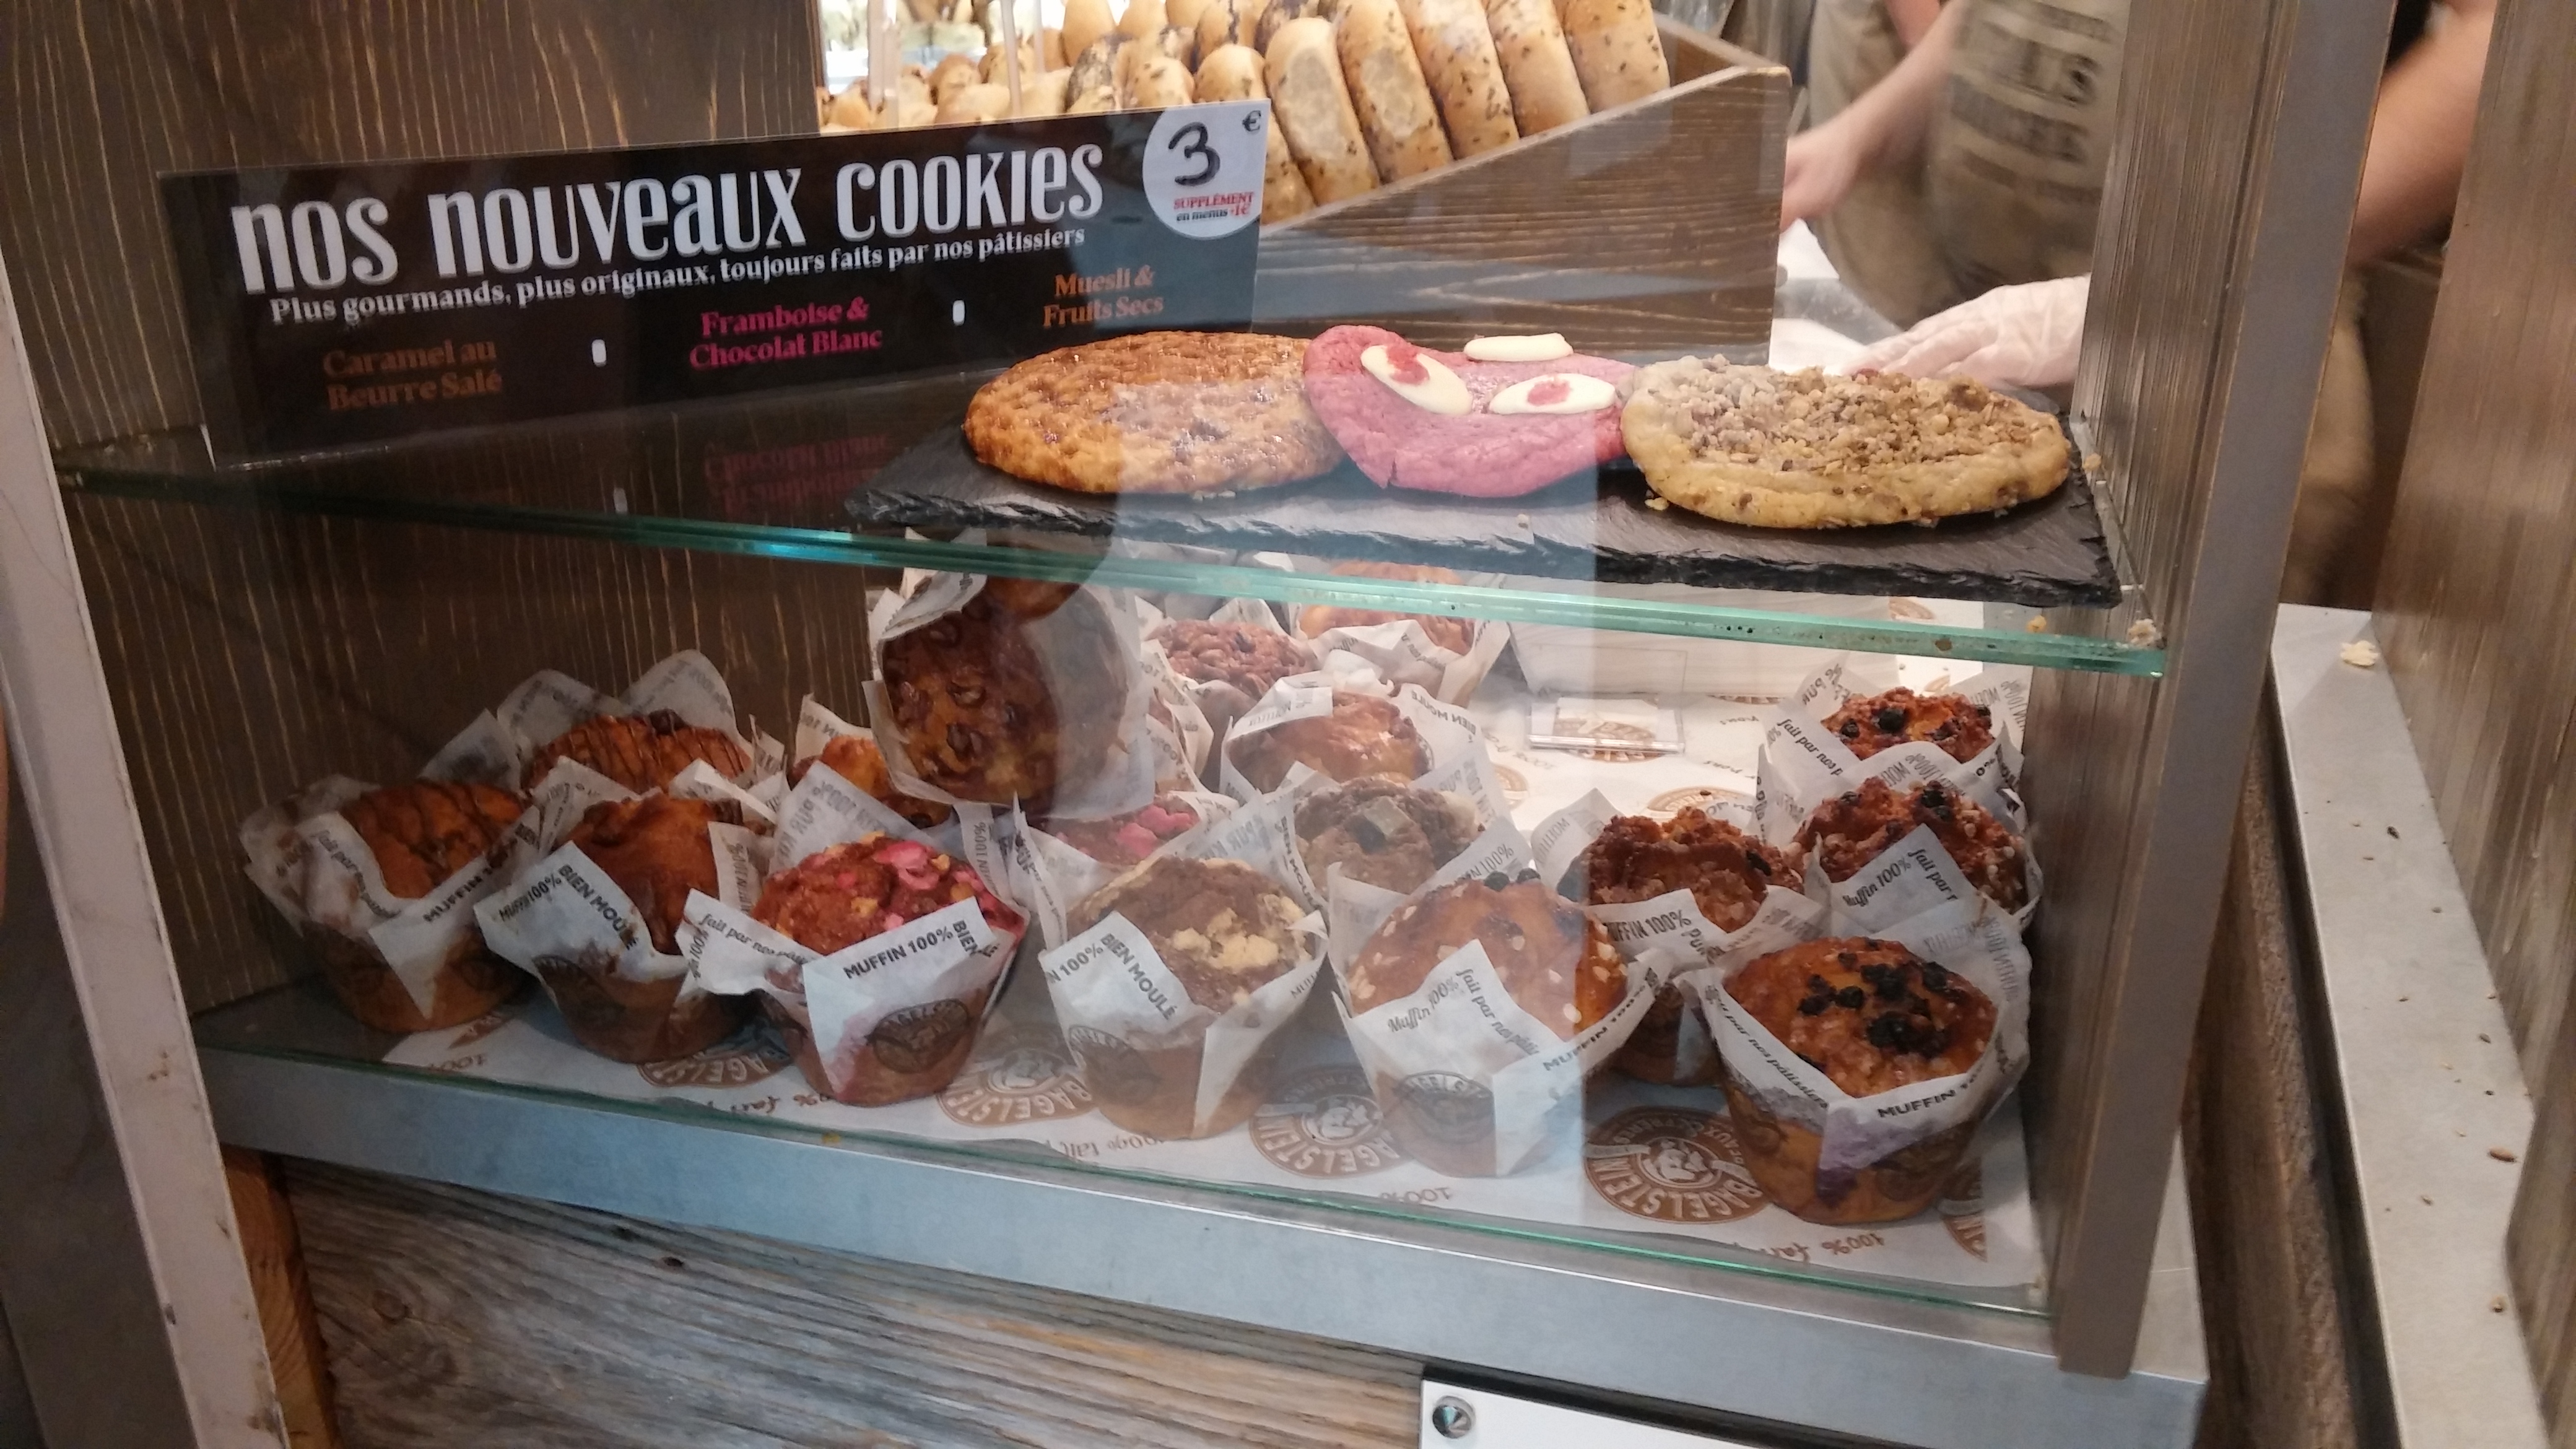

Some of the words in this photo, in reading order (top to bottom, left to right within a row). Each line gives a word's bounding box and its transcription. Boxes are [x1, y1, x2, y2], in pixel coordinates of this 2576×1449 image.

[1168, 122, 1221, 186] 3
[1242, 110, 1262, 133] €
[1176, 212, 1190, 222] en
[1192, 208, 1228, 220] menus
[230, 197, 399, 295] nos
[269, 296, 337, 325] Plus
[342, 280, 511, 327] gourmands,
[516, 275, 576, 309] plus
[581, 263, 716, 298] originaux,
[720, 253, 824, 284] toujours
[830, 245, 882, 272] faits
[889, 243, 929, 272] par
[934, 238, 973, 261] nos
[979, 227, 1086, 262] pâtissiers
[1055, 268, 1131, 298] Muesli
[1134, 264, 1155, 287] &
[700, 302, 843, 338] Framboise
[846, 295, 870, 321] &
[1043, 300, 1112, 329] Fruits
[1115, 296, 1164, 317] Secs
[322, 339, 456, 378] Caramel
[460, 341, 497, 362] au
[689, 333, 806, 370] Chocolat
[812, 328, 883, 355] Blanc
[327, 380, 437, 411] Beurre
[440, 368, 503, 399] Salé
[1795, 734, 1819, 753] par
[1817, 752, 1837, 771] nos
[973, 822, 988, 856] 100%
[1479, 843, 1514, 872] 100%
[529, 873, 562, 902] 100%
[559, 864, 595, 900] BIEN
[1876, 858, 1913, 887] 100%
[1907, 848, 1936, 872] fait
[1925, 871, 1952, 893] par
[698, 913, 728, 933] fait
[726, 928, 752, 944] par
[1644, 908, 1692, 935] 100%
[843, 944, 907, 980] MUFFIN
[908, 925, 954, 954] 100%
[1060, 943, 1104, 976] 100%
[1100, 933, 1135, 965] BIEN
[1128, 963, 1178, 1020] MOULÉ
[1456, 968, 1482, 994] fait
[1471, 996, 1496, 1019] par
[1387, 1006, 1431, 1032] Muffin
[1428, 976, 1460, 1009] 100%
[1543, 1026, 1608, 1071] MUFFIN
[1725, 1015, 1751, 1036] par
[1748, 1037, 1771, 1058] nos
[1766, 1058, 1830, 1108] pâtissiers
[1877, 1089, 1957, 1118] MUFFIN
[1252, 1116, 1401, 1175] AGELSTEIN
[1822, 1233, 1885, 1256] 100%
